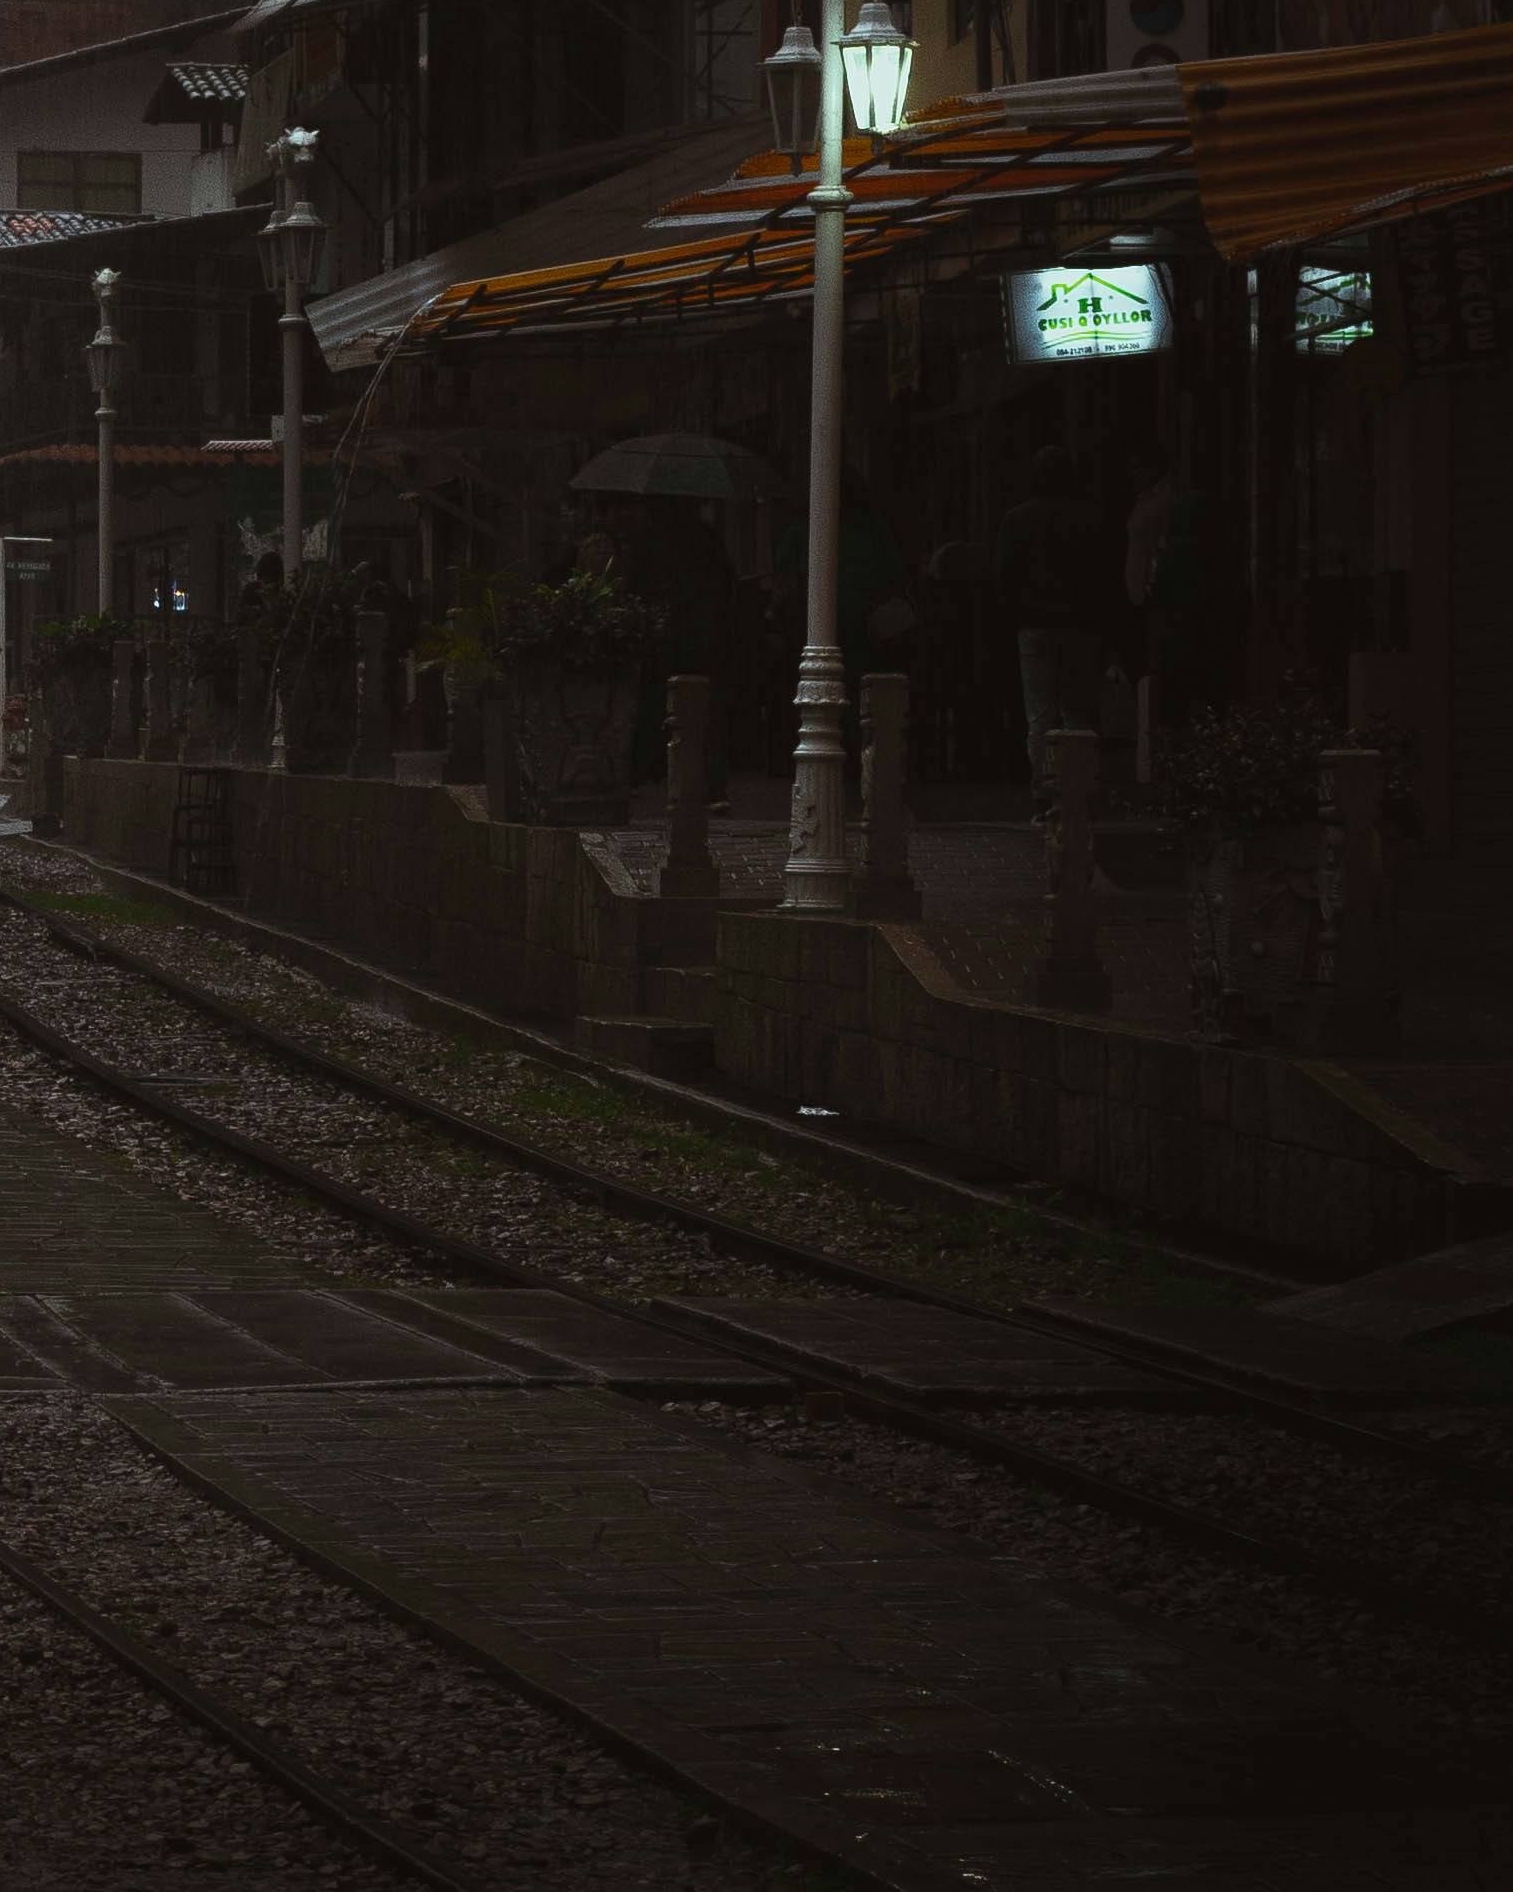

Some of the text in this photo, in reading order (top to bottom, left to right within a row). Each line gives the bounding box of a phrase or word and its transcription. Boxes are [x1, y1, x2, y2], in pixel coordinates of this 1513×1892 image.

[1078, 297, 1102, 313] H
[1038, 317, 1073, 331] CUSI
[1092, 310, 1152, 326] OYLLOR
